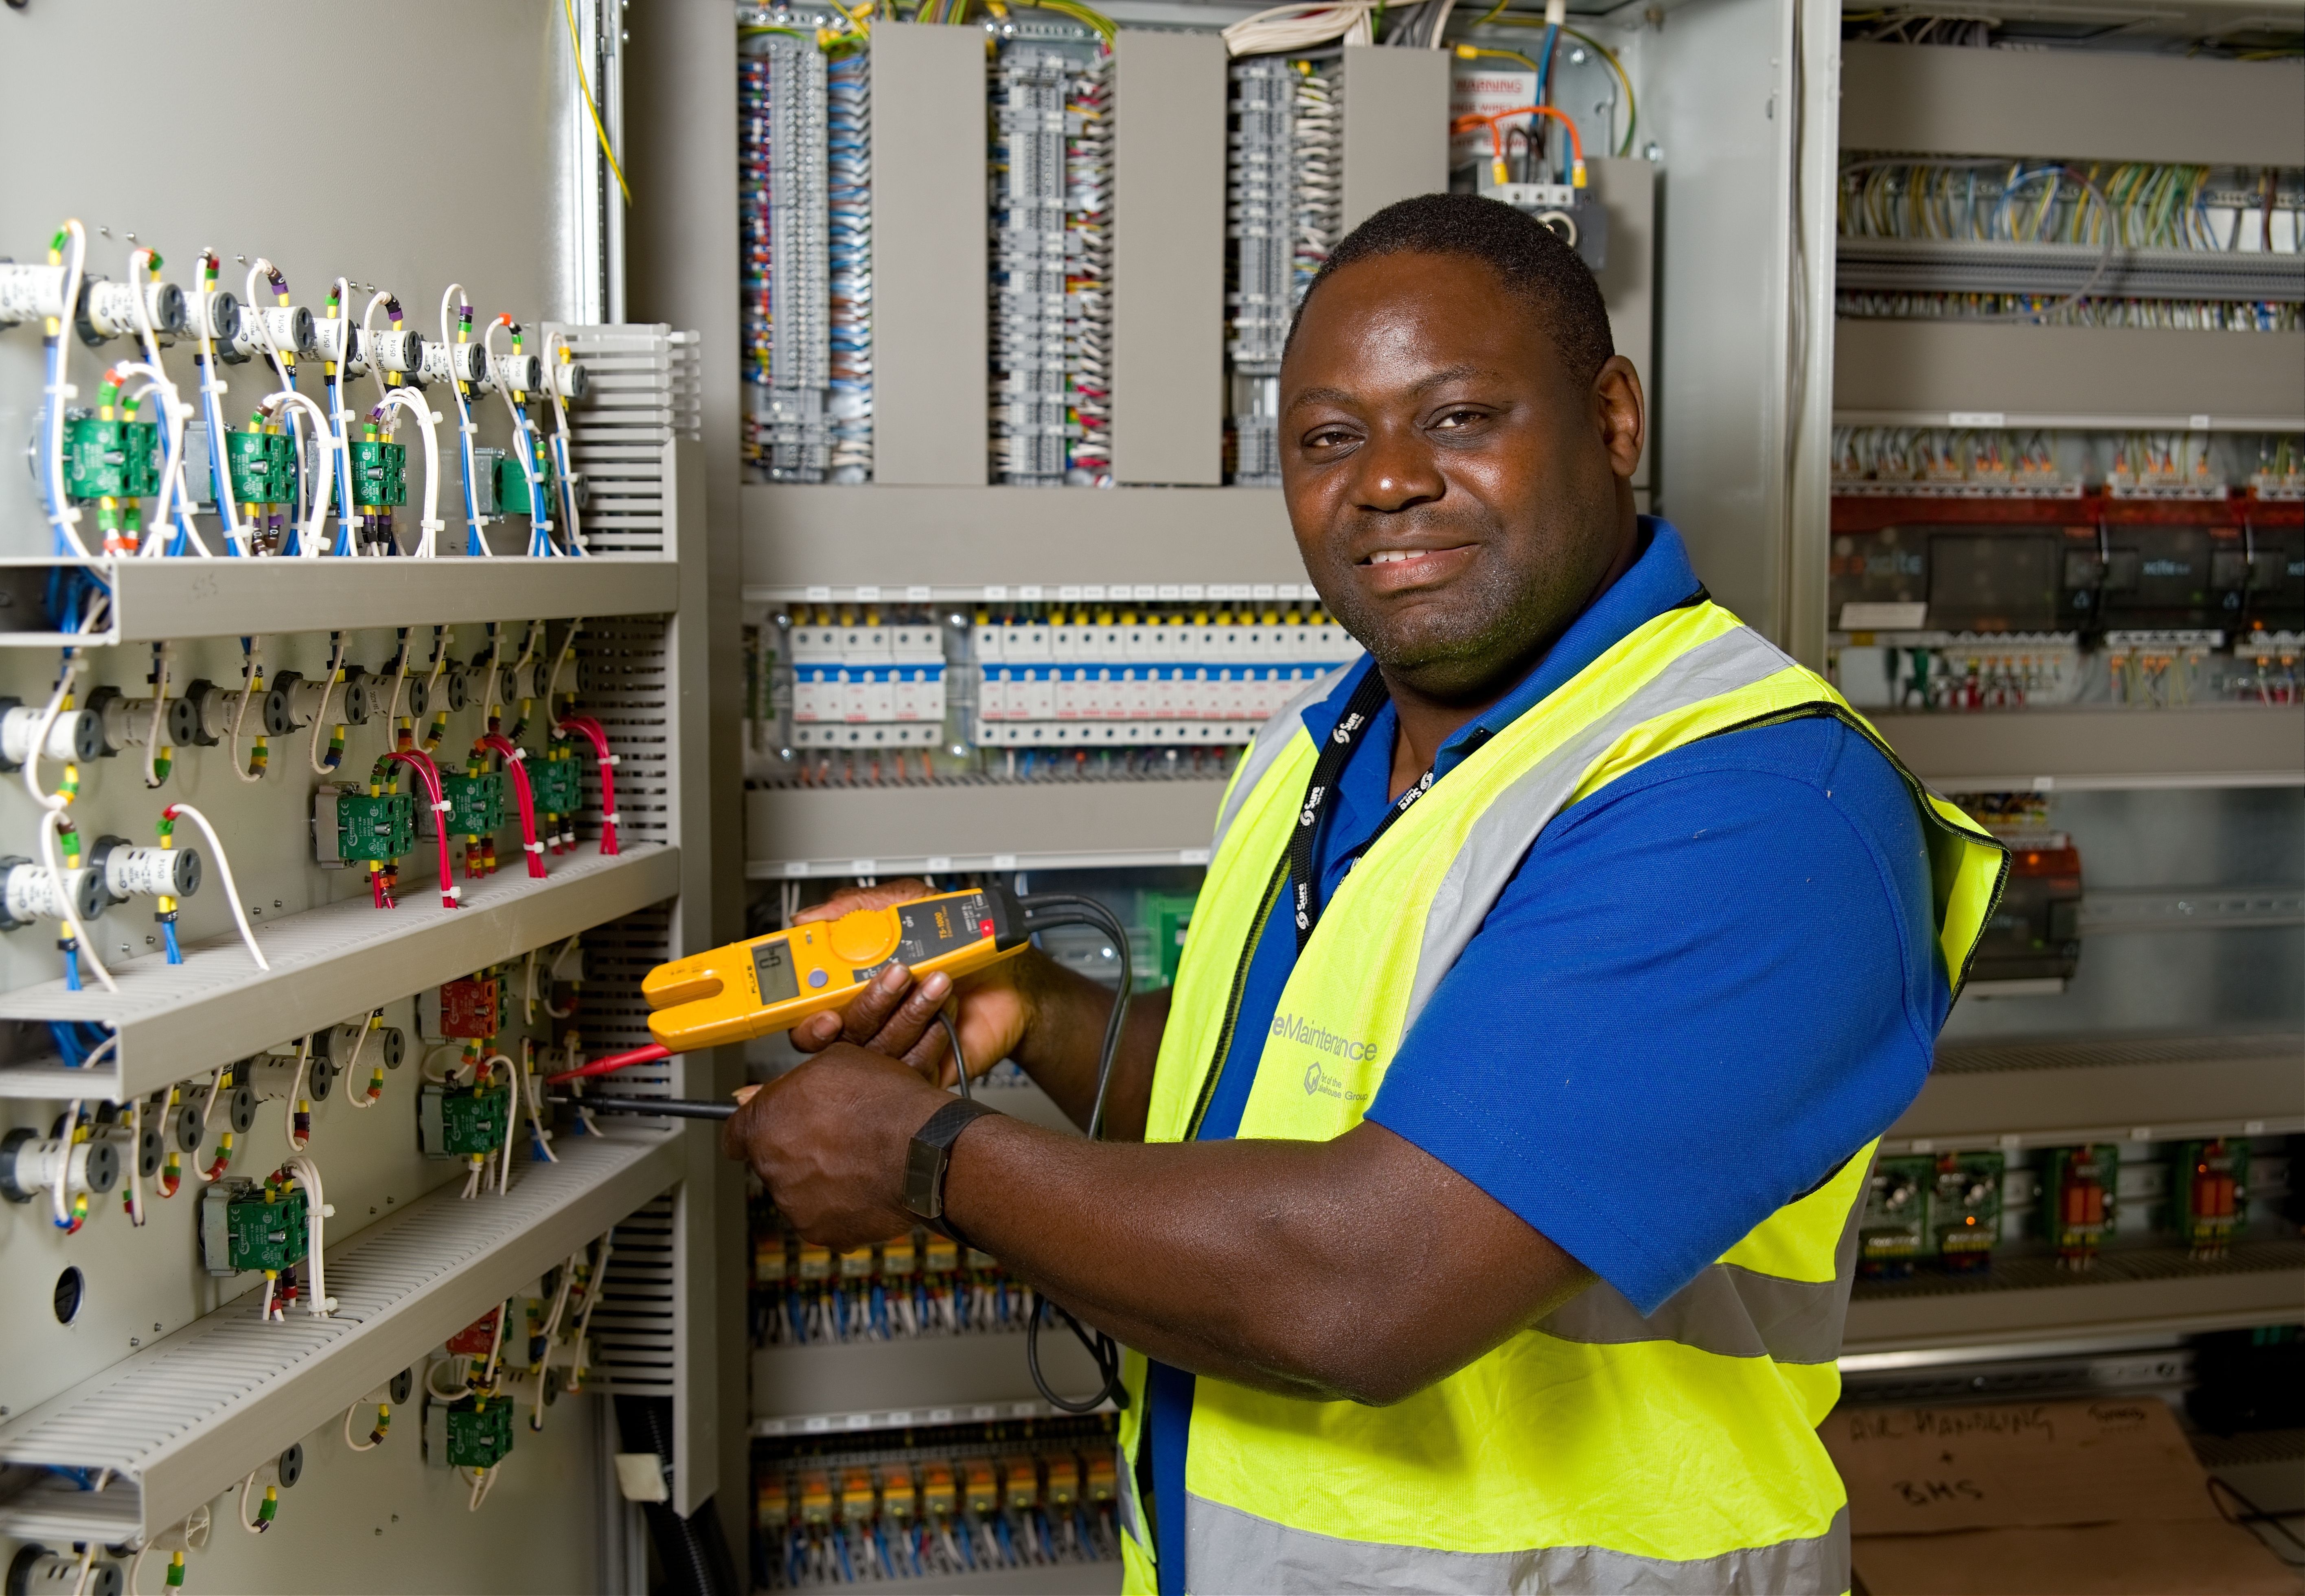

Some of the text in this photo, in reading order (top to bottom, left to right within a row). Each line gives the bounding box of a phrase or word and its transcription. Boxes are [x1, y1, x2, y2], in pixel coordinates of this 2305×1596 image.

[388, 457, 392, 469] NO
[394, 480, 397, 493] NO
[370, 691, 378, 704] AC/DC
[1339, 713, 1360, 731] Sure
[1304, 787, 1320, 810] Sure
[1400, 787, 1423, 810] Sure
[396, 810, 399, 821] NO
[401, 831, 404, 843] NO
[158, 859, 166, 879] 05/14
[1297, 884, 1306, 911] Sure
[905, 915, 914, 928] OFF
[934, 912, 948, 940] T5-1000
[747, 965, 756, 994] FLUKE
[1273, 1013, 1377, 1061] eMaintenance
[1332, 1078, 1342, 1089] the
[1344, 1090, 1368, 1102] Group
[291, 1212, 295, 1224] NO
[298, 1232, 302, 1245] NO
[1850, 1414, 1903, 1442] AIR
[1914, 1405, 2054, 1443] HANDLING
